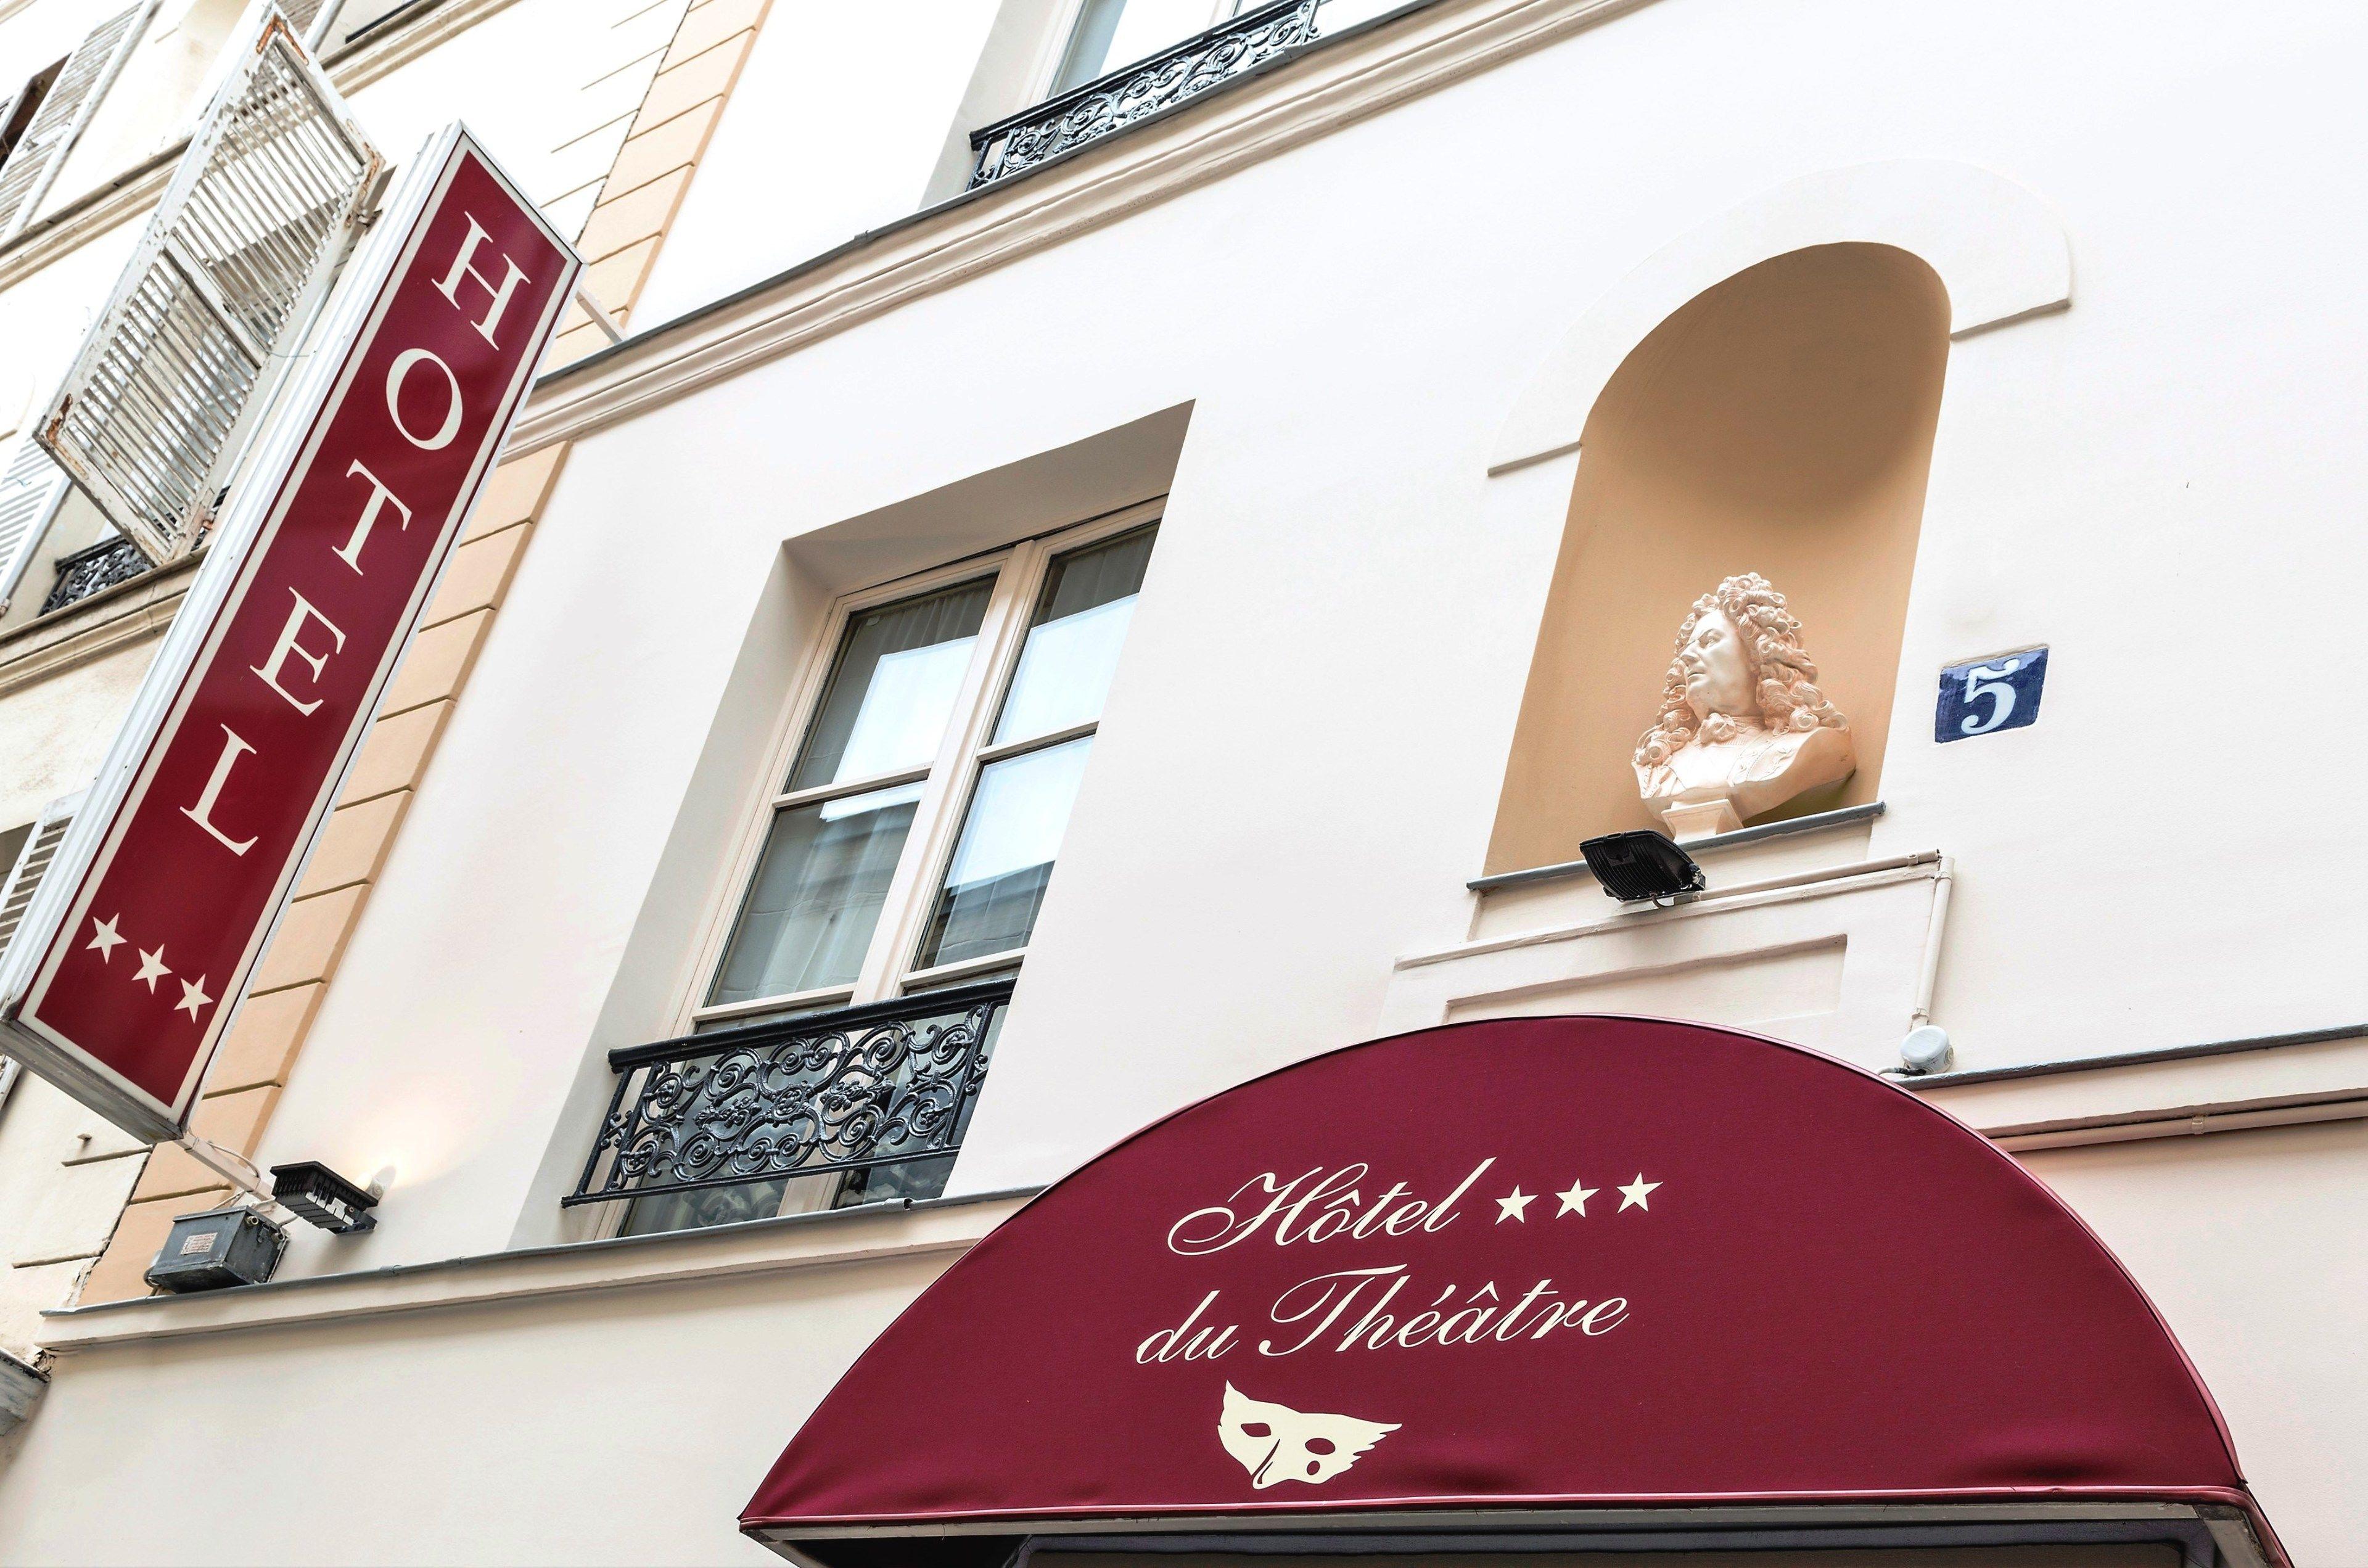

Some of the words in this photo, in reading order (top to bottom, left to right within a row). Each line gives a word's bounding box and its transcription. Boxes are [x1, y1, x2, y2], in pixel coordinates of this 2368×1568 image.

[179, 211, 531, 856] HOTEL
[1960, 659, 2021, 735] 5
[1167, 1157, 1497, 1255] Hôtel
[1136, 1290, 1239, 1365] du
[1258, 1263, 1630, 1357] Théâtre
